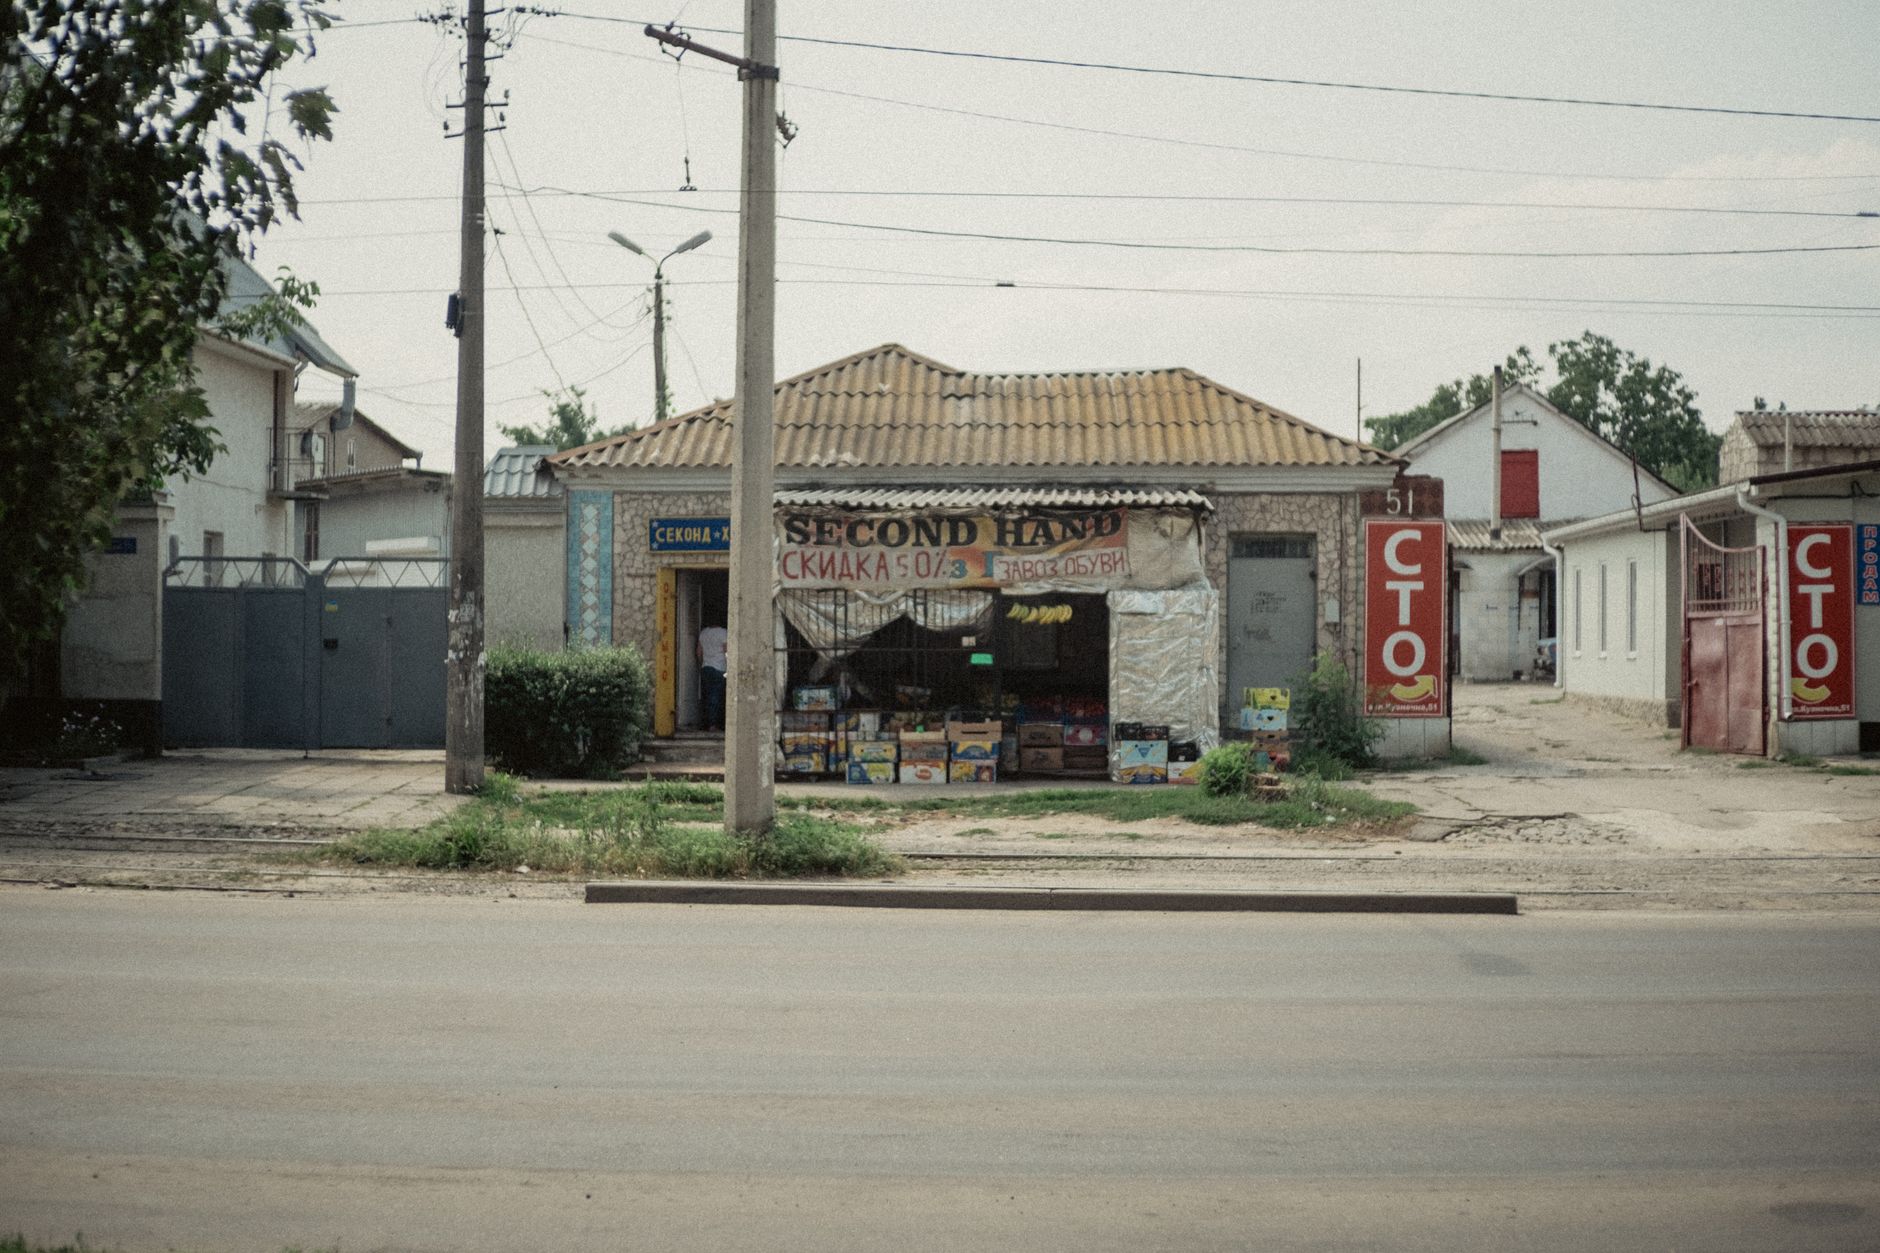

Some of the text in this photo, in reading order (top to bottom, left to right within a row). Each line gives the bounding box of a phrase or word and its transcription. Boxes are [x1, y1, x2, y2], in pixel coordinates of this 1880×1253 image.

[1386, 489, 1414, 515] 51
[655, 527, 711, 544] СЕКОНД
[784, 512, 1122, 547] SECOND HAND
[783, 549, 946, 581] СКИДКА 50%
[999, 559, 1057, 581] ЗАВОЗ
[1065, 552, 1124, 576] ОБУВИ
[1863, 526, 1879, 603] ПРОДАМ
[1383, 530, 1426, 677] СТО
[1796, 533, 1839, 679] СТО
